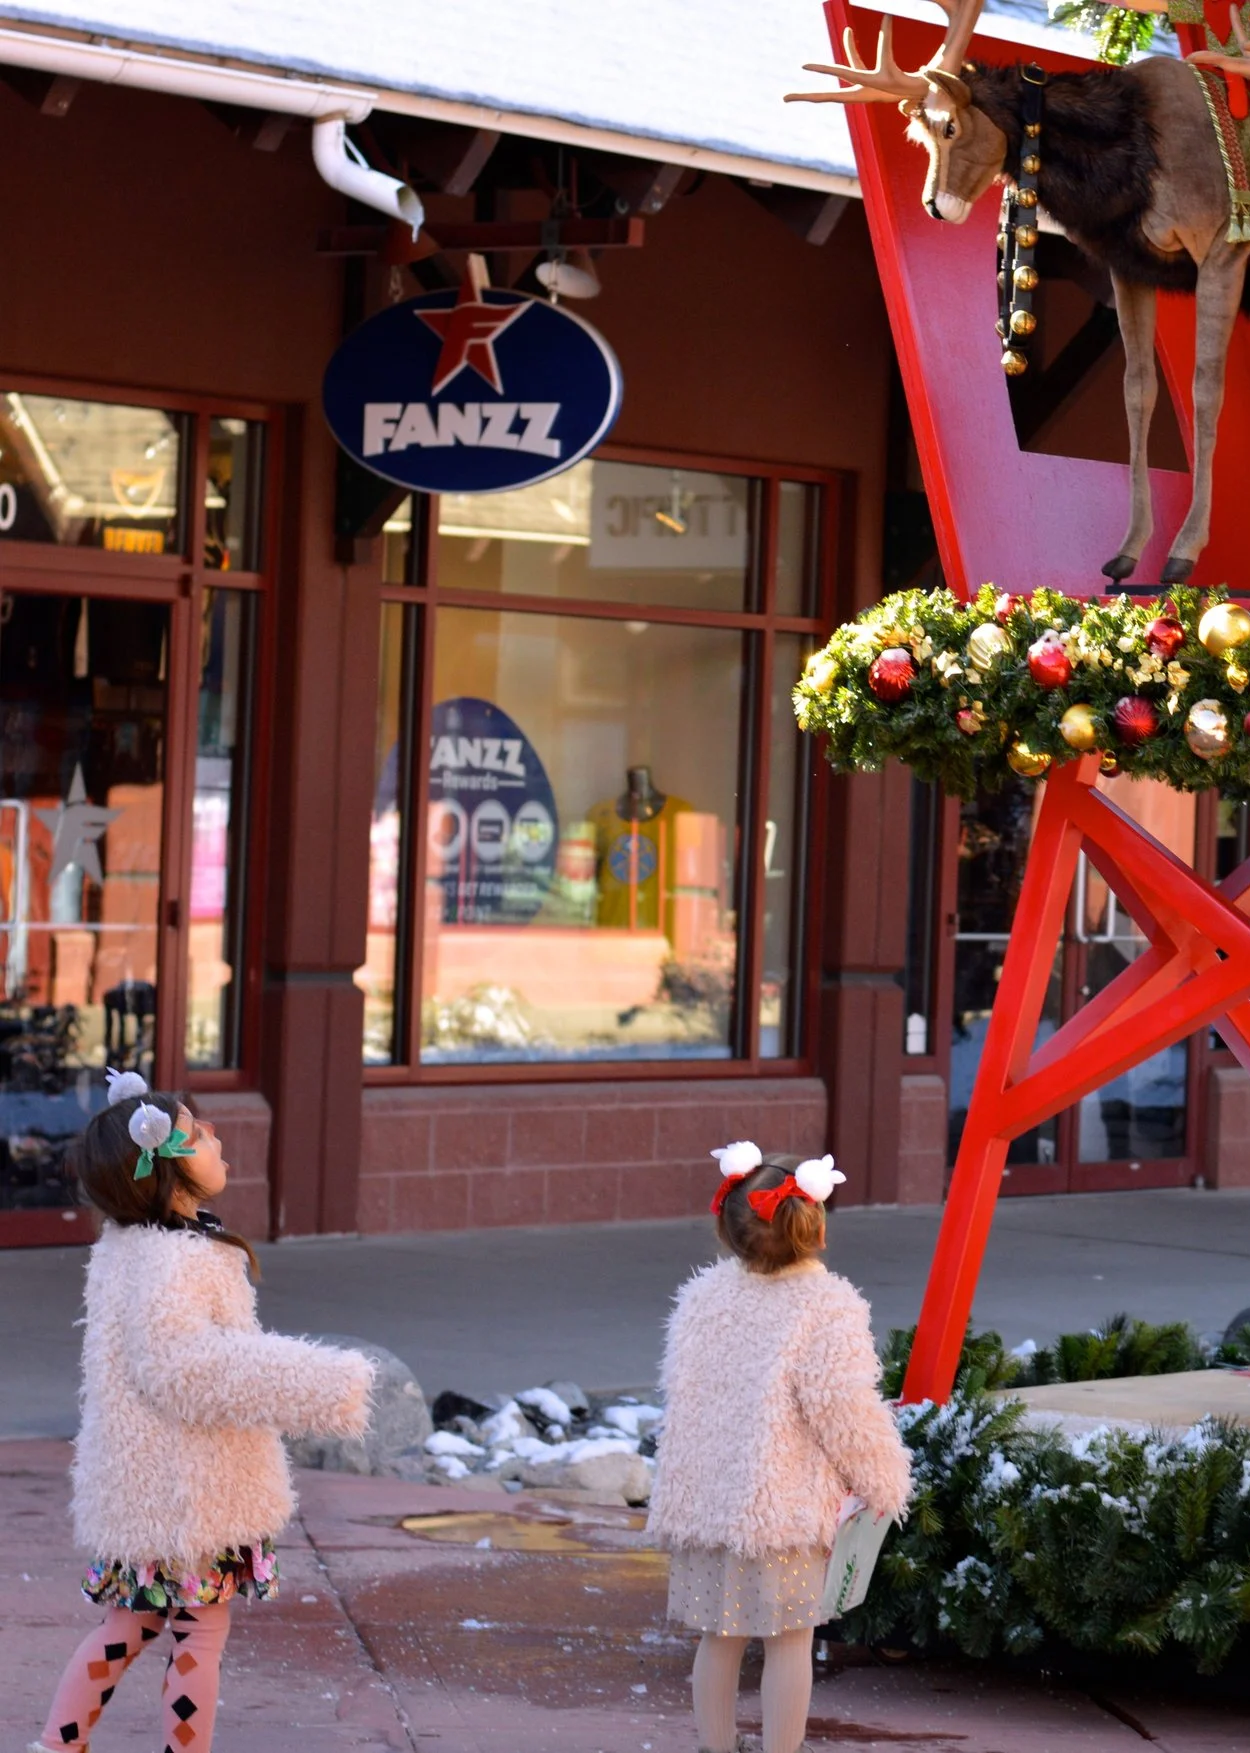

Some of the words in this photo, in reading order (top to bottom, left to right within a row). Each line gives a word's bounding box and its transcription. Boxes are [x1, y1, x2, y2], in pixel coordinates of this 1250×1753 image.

[363, 402, 561, 459] FANZZ
[430, 735, 527, 777] ANZZ
[442, 771, 499, 791] Rewards
